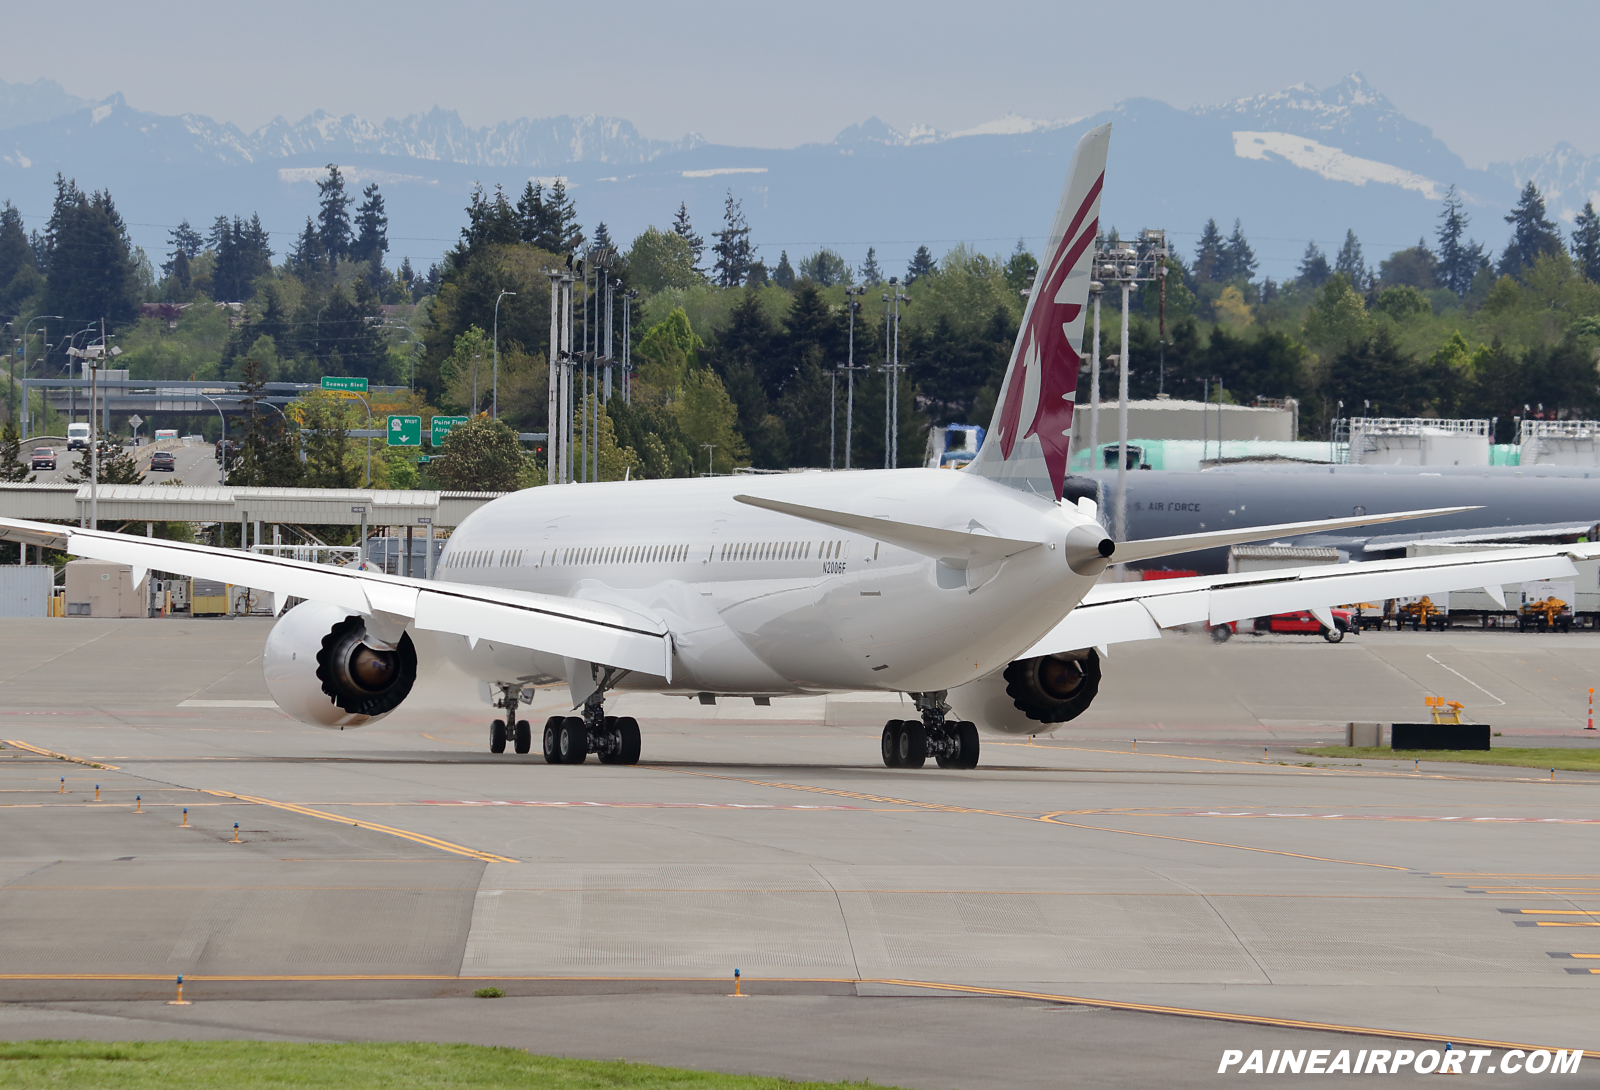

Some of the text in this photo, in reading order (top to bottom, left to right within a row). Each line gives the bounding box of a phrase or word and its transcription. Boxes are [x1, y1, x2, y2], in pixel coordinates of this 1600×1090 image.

[1148, 502, 1164, 511] AIR
[1167, 502, 1201, 512] FORCE
[822, 561, 846, 574] N2006F
